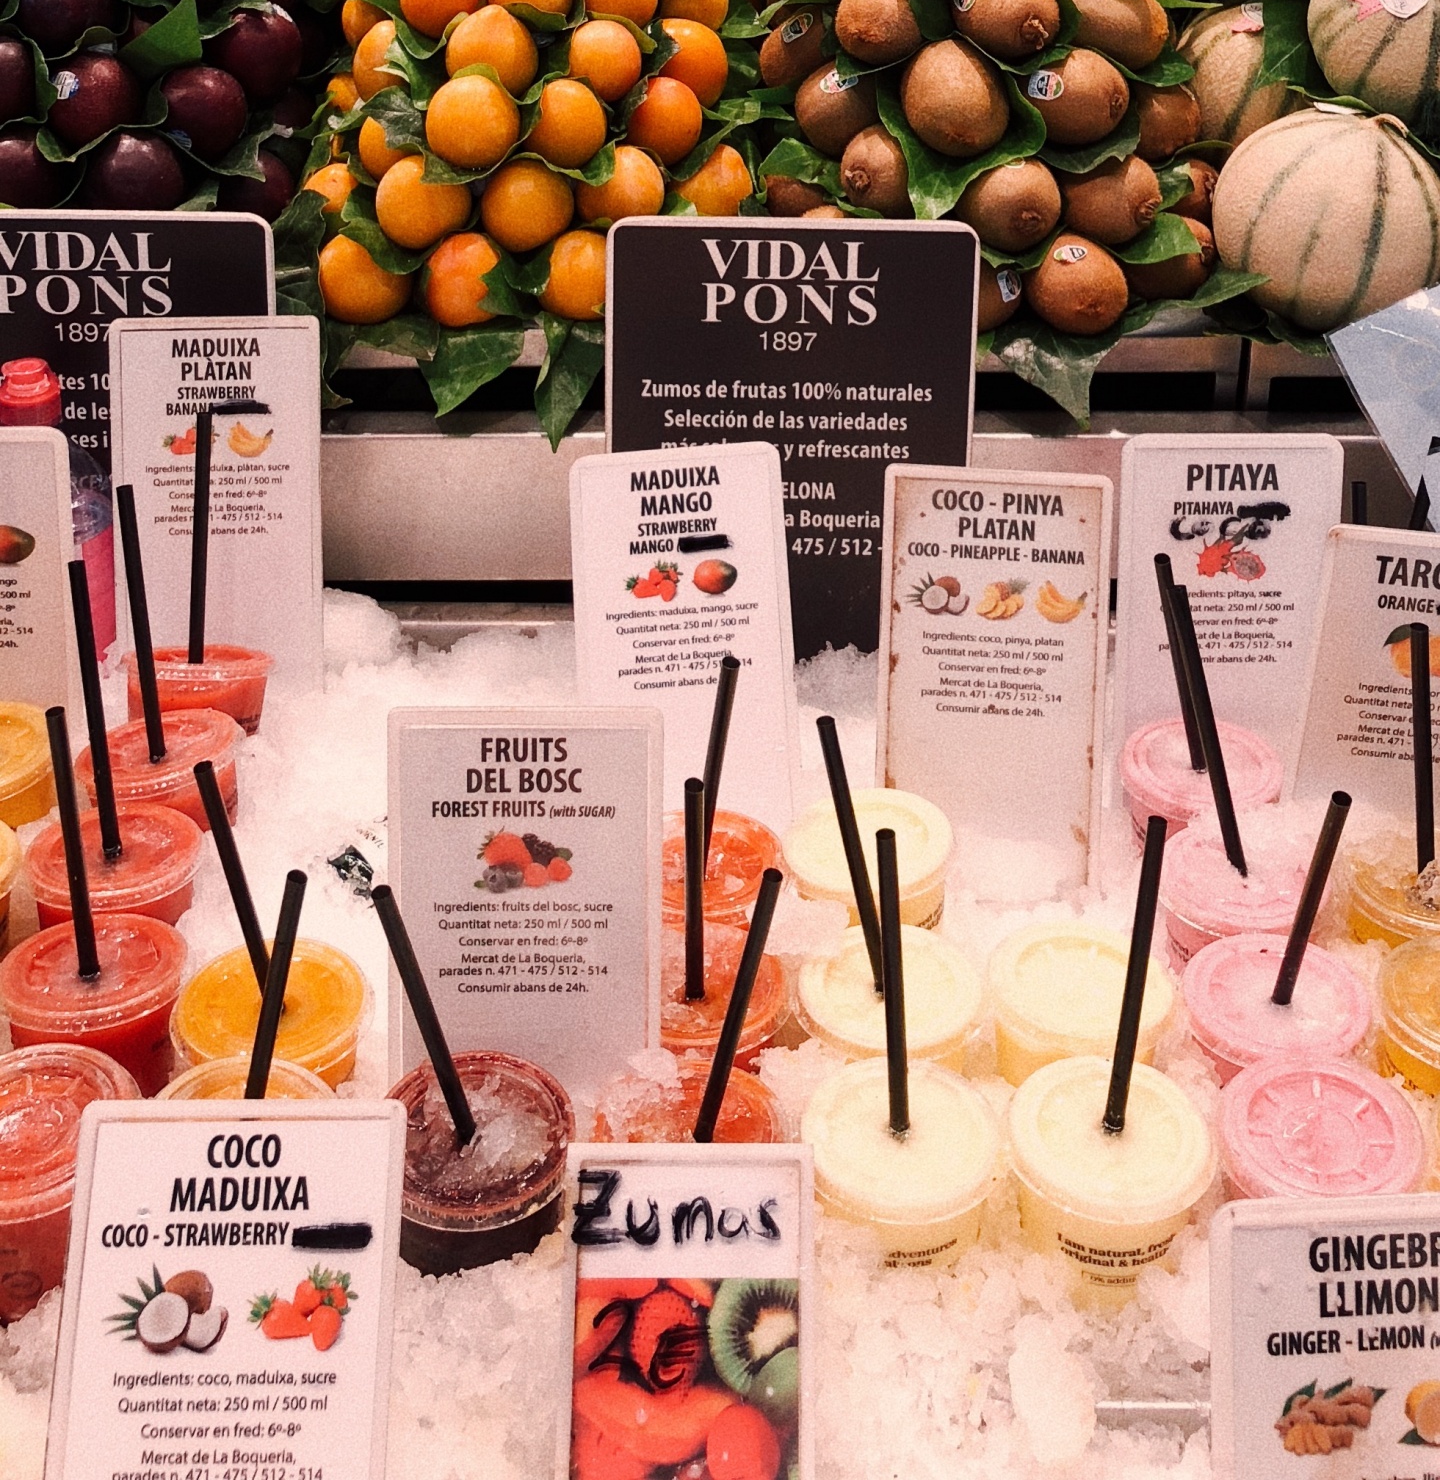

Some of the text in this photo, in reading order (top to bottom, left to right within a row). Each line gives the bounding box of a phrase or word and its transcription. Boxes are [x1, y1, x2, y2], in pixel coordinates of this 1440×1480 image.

[0, 231, 172, 272] VIDAL
[701, 238, 880, 283] VIDAL
[0, 275, 173, 316] PONS
[701, 283, 877, 326] PONS
[172, 338, 261, 357] MADUIXA
[759, 332, 818, 352] 1897
[181, 359, 252, 380] PLÀTAN
[177, 386, 256, 400] STRAWBERRY
[641, 379, 933, 403] Zumos de frutas 100% naturales
[64, 402, 87, 421] de
[664, 409, 907, 431] Selección de las variedades
[784, 444, 794, 461] y
[798, 441, 910, 460] refrescantes
[631, 465, 720, 492] MADUIXA
[1187, 464, 1279, 491] PITAYA
[782, 481, 835, 500] ELONA
[641, 492, 712, 516] MANGO
[932, 489, 1064, 517] COCO PINYA
[1174, 501, 1234, 515] PITAHAYA
[638, 518, 717, 537] STRAWBERRY
[800, 510, 880, 531] Boqueria
[958, 517, 1036, 541] PLATAN
[630, 539, 674, 555] MANGO
[792, 538, 872, 556] 475 512
[908, 542, 1085, 565] COCO PINEAPPLE BANANA
[1378, 594, 1435, 614] ORANGE
[481, 738, 568, 762] FRUITS
[466, 768, 582, 793] DEL BOSC
[432, 801, 616, 819] FOREST FRUITS (with SUGAR)
[434, 902, 612, 914] Ingredients: fruits del bosc, sucre
[438, 919, 608, 930] Quantitat neta: 250 ml 500 ml
[459, 936, 514, 946] Conservar
[517, 938, 530, 946] en
[534, 936, 558, 946] fred:
[462, 954, 586, 966] Mercat de La Boqueria,
[439, 966, 608, 978] parades n. 471 475 512 514
[458, 982, 588, 992] Consumir abans de 24h.
[208, 1134, 281, 1169] COCO
[170, 1176, 309, 1212] MADUIXA
[102, 1222, 289, 1248] COCO STRAWBERRY
[1061, 1246, 1115, 1267] original
[1064, 1238, 1085, 1252] am
[1088, 1248, 1145, 1257] natural,
[1267, 1325, 1425, 1356] GINGER LEMON
[113, 1371, 336, 1389] Ingredients: coco, maduixa, sucre
[118, 1396, 327, 1412] Quantitat neta: 250 ml 500 ml
[141, 1424, 209, 1438] Conservar
[213, 1426, 230, 1437] en
[233, 1423, 264, 1437] fred:
[141, 1449, 296, 1467] Mercat de La Boqueria,
